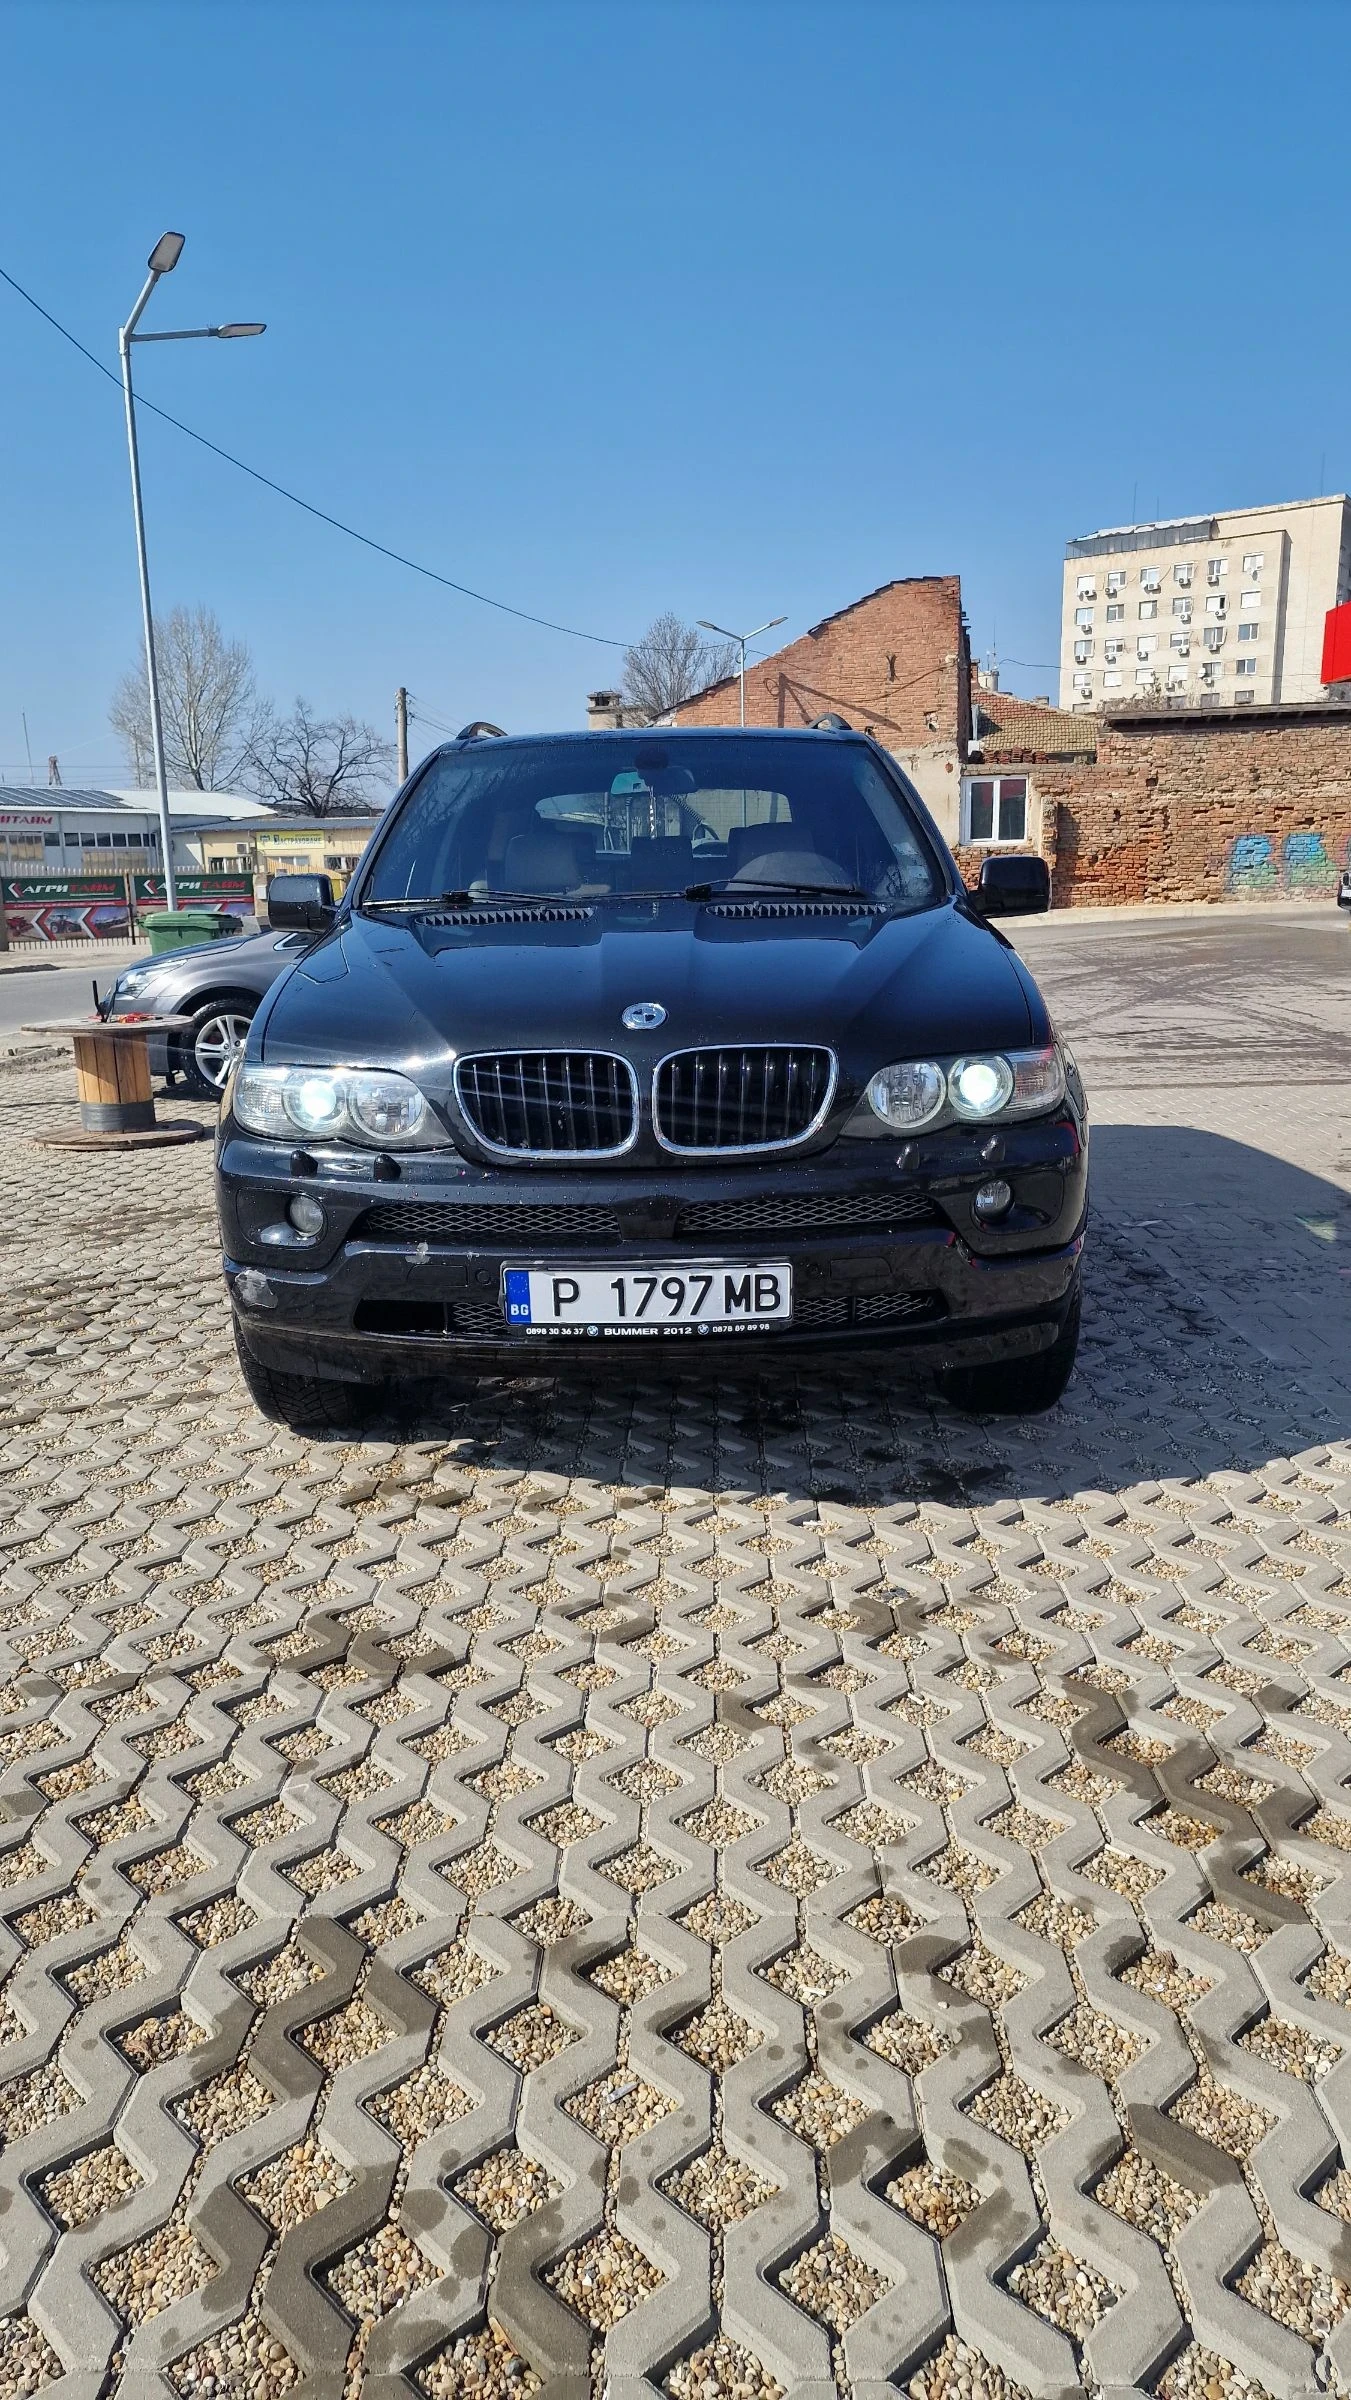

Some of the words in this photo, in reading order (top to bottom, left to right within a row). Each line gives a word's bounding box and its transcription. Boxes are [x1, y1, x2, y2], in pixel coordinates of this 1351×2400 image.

[552, 1277, 580, 1317] P
[610, 1275, 713, 1317] 1797
[723, 1273, 781, 1314] MB
[510, 1303, 529, 1316] BG
[526, 1327, 547, 1335] 0898
[548, 1327, 559, 1335] 30
[561, 1327, 572, 1335] 36
[573, 1327, 584, 1335] 37
[604, 1327, 659, 1336] BUMMER
[663, 1327, 693, 1335] 2012
[712, 1325, 733, 1333] 0878
